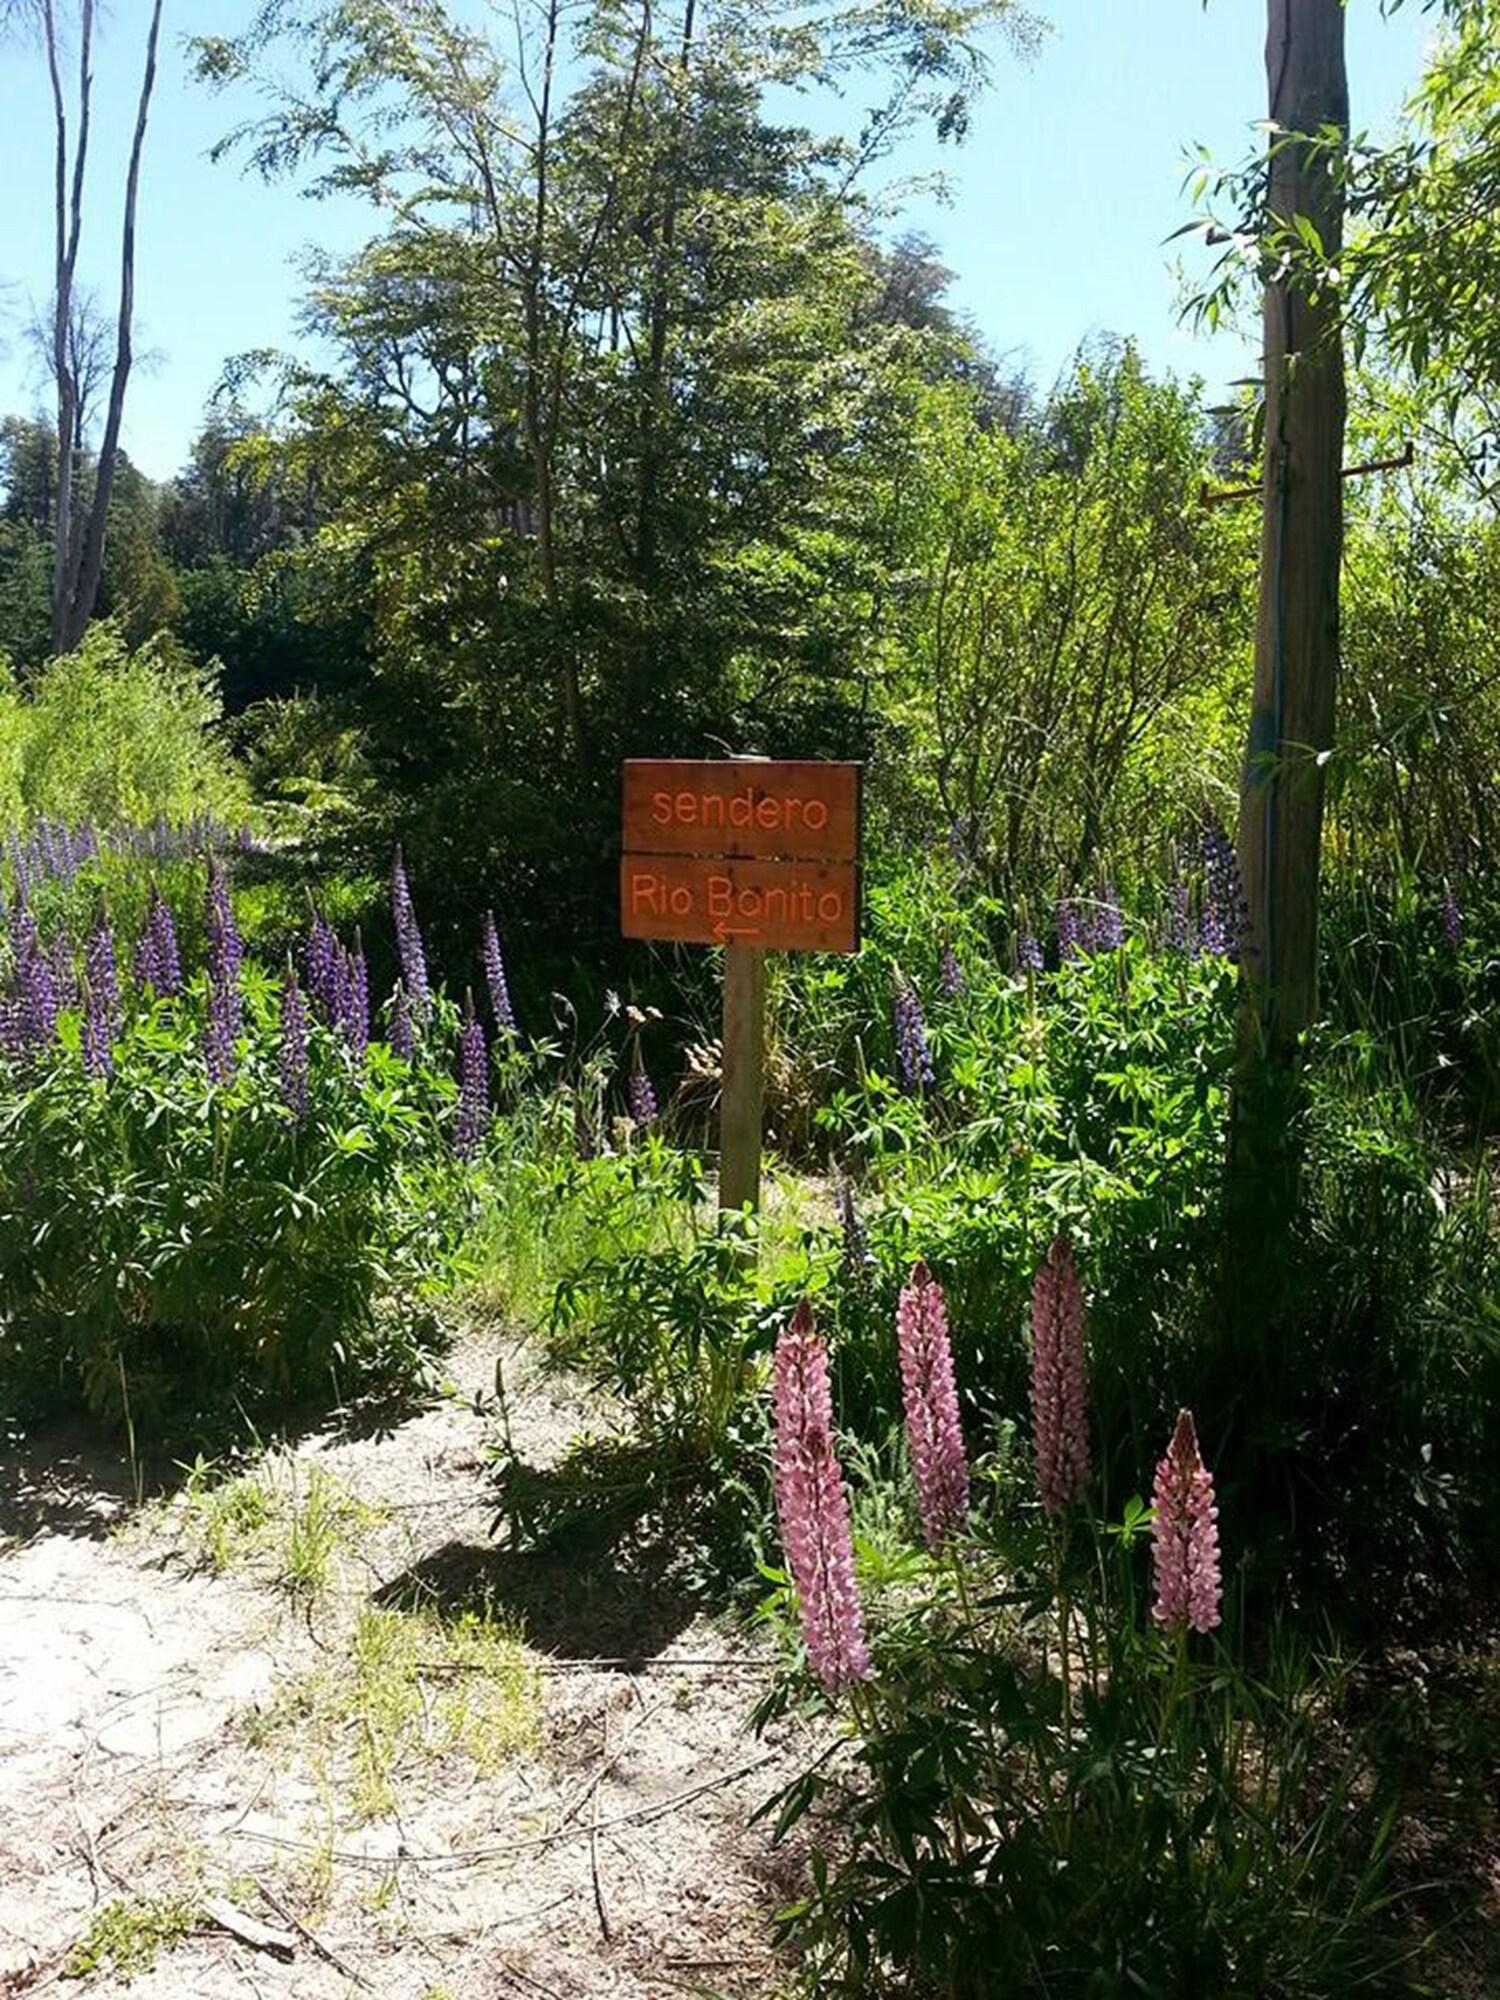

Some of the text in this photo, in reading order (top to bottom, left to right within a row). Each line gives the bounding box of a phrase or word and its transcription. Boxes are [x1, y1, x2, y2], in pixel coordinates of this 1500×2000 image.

[652, 787, 828, 830] sendero
[631, 874, 843, 922] Rio Bonito
